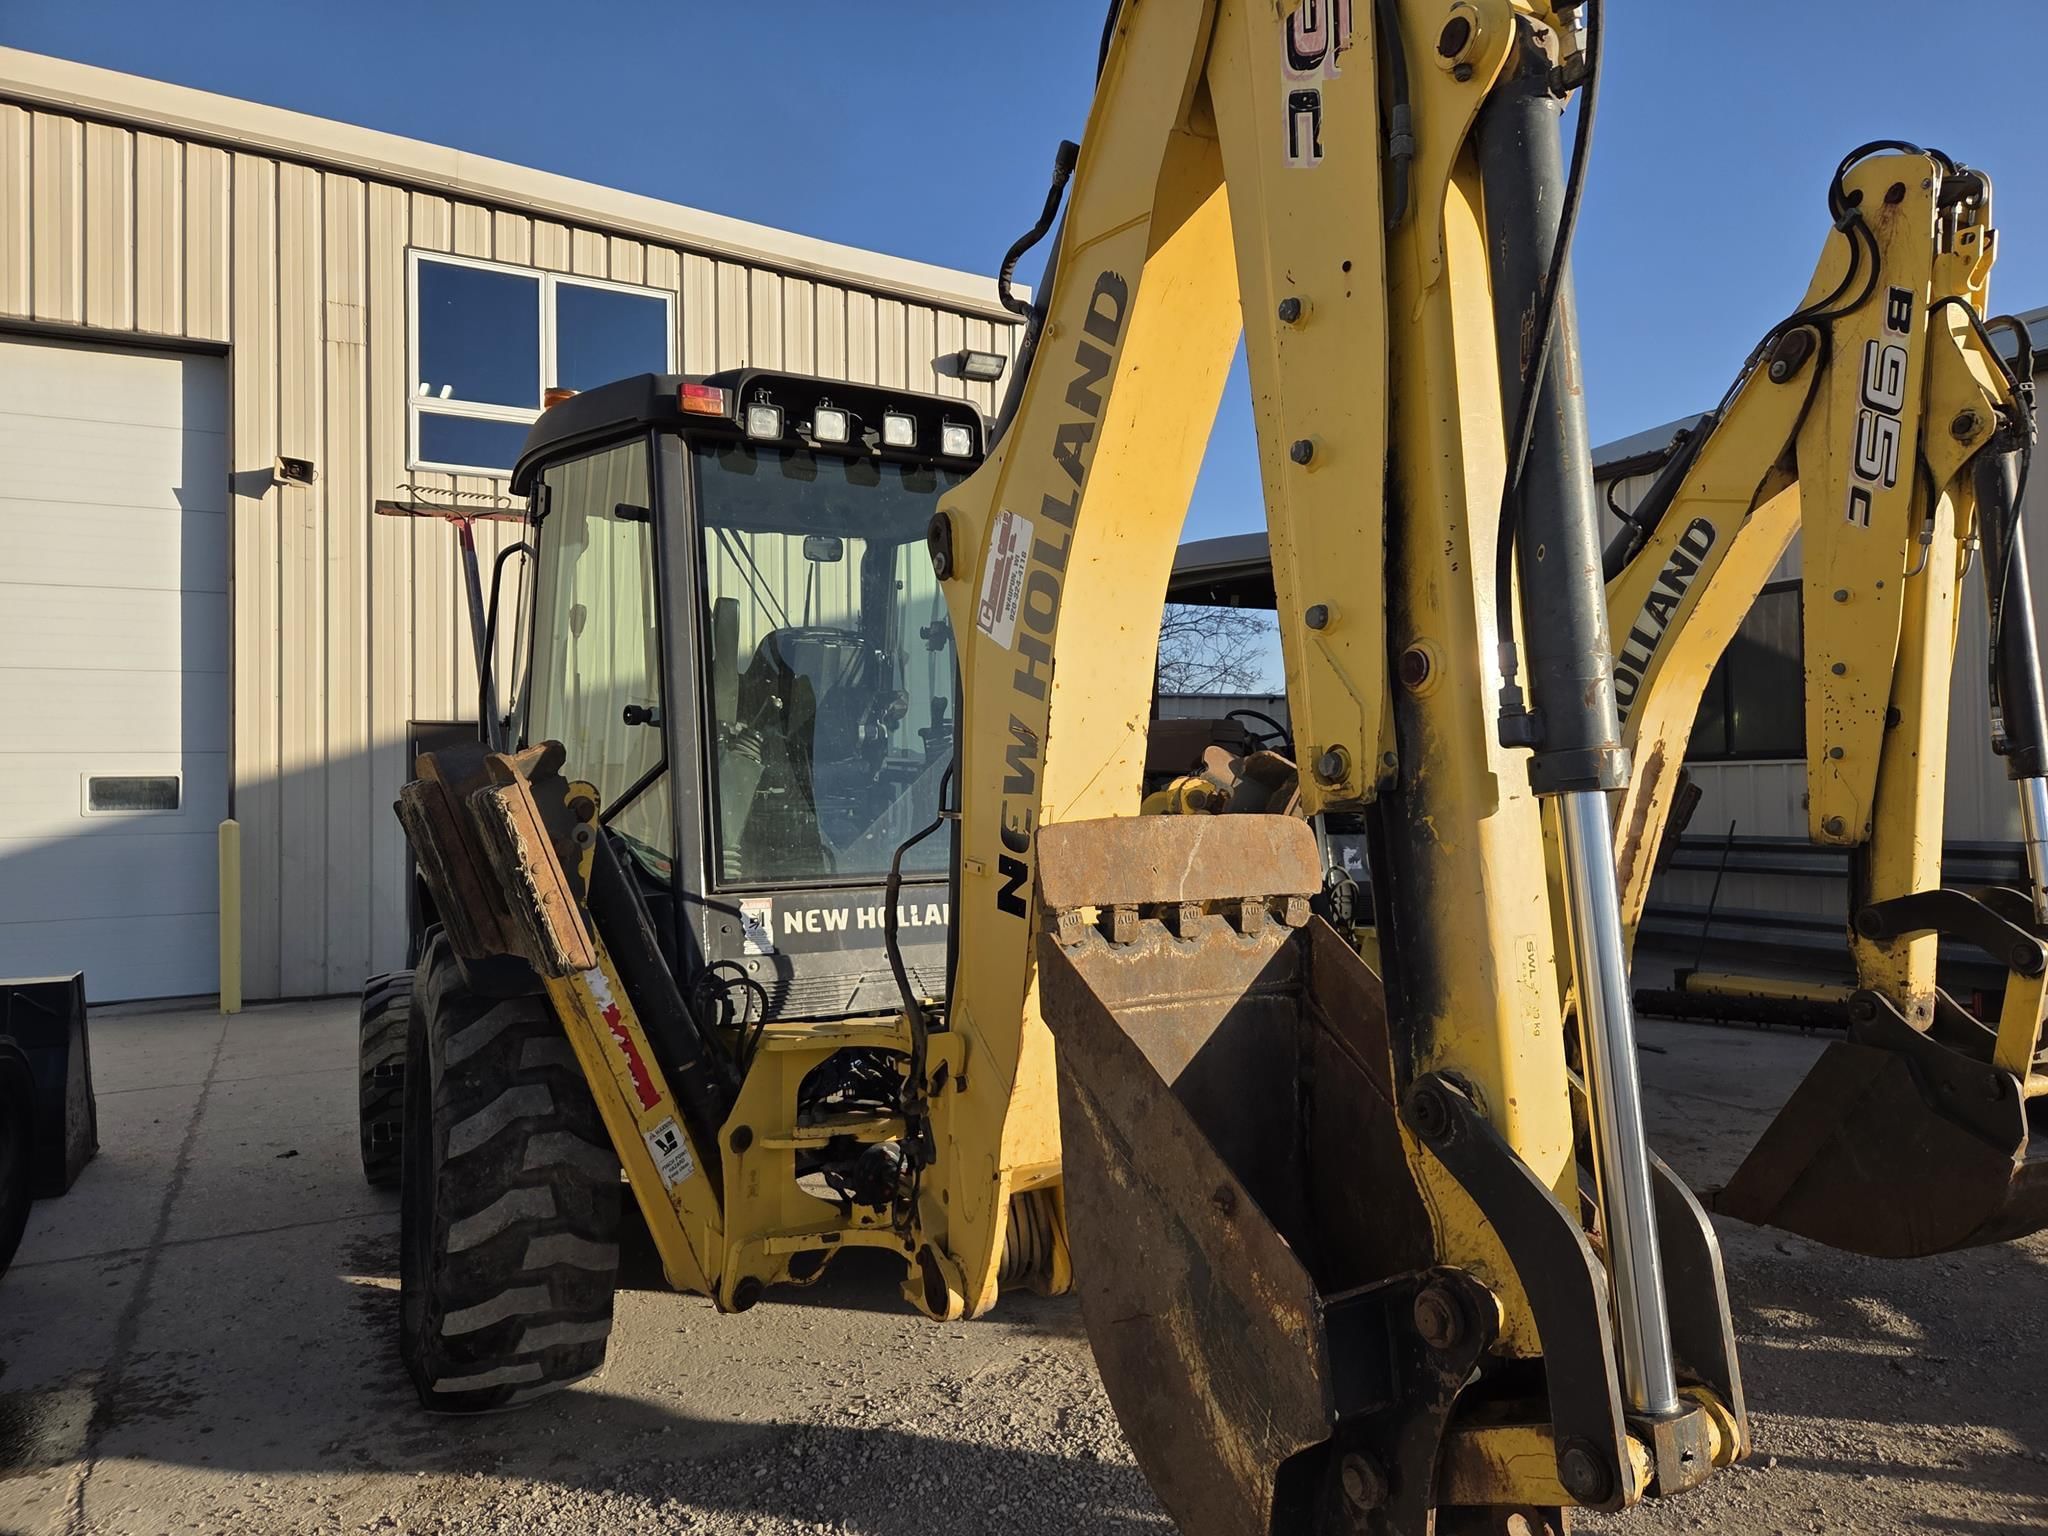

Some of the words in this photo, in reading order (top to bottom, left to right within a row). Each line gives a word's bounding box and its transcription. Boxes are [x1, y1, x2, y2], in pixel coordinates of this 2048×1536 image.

[1013, 270, 1130, 701] HOLLAND
[1613, 517, 1716, 723] OLLAND
[783, 908, 849, 934] NEW
[856, 903, 950, 930] HLLA
[997, 713, 1040, 919] NEW
[1527, 941, 1536, 979] SWL
